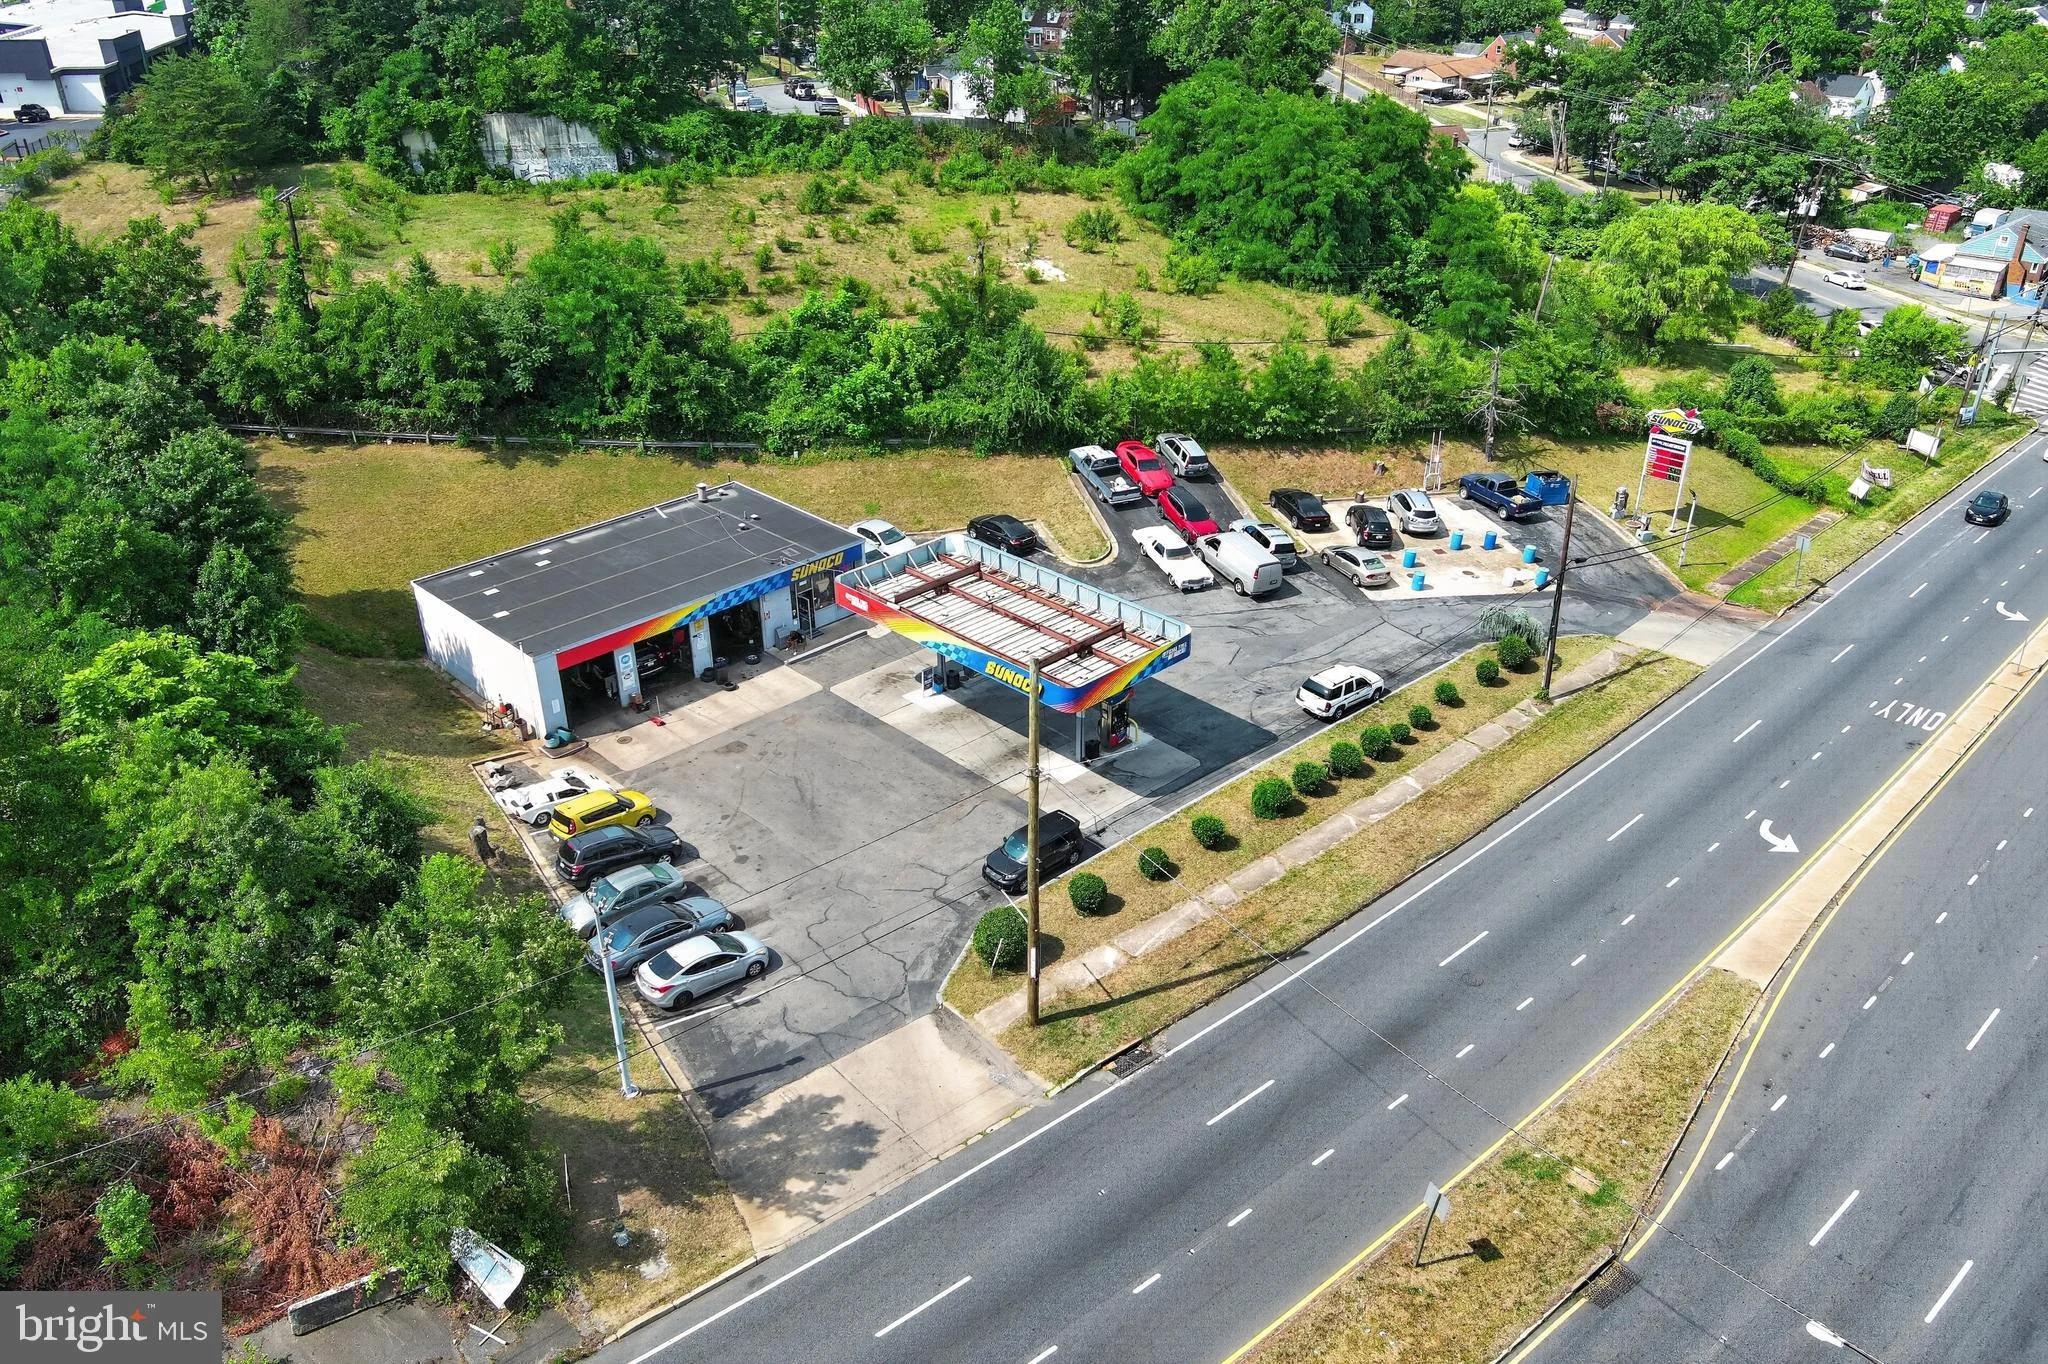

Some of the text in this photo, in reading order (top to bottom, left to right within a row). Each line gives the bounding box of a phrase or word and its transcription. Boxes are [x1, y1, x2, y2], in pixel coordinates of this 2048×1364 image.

[1651, 414, 1695, 431] SUNOCO
[791, 552, 844, 582] SUNOCO
[985, 661, 1042, 693] SUNOC
[1874, 699, 1947, 731] ONLY
